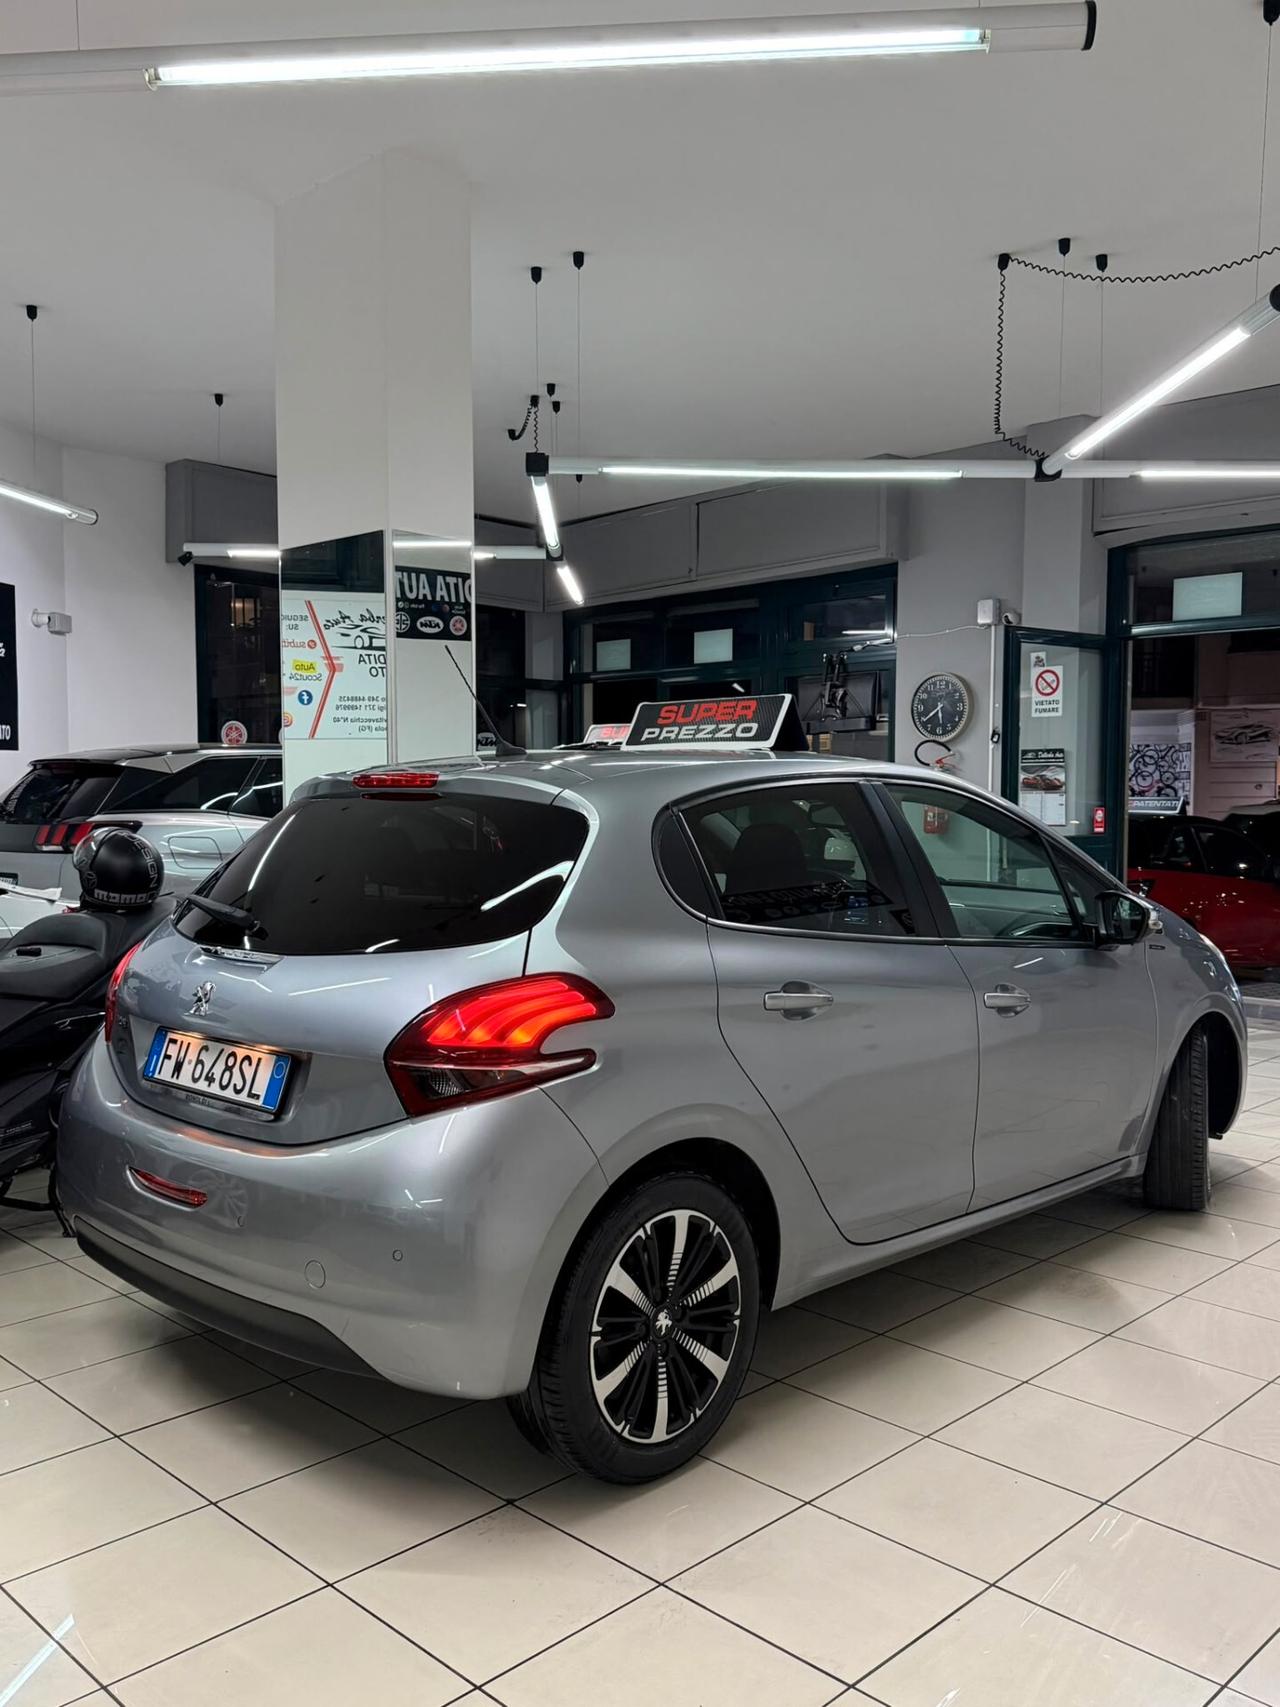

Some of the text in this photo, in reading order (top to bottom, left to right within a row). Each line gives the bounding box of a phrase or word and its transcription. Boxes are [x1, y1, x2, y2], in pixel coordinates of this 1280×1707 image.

[656, 699, 759, 725] SUPER
[1034, 706, 1060, 714] FUMARE
[640, 722, 759, 742] PREZZO
[157, 1037, 261, 1101] FW 648SL
